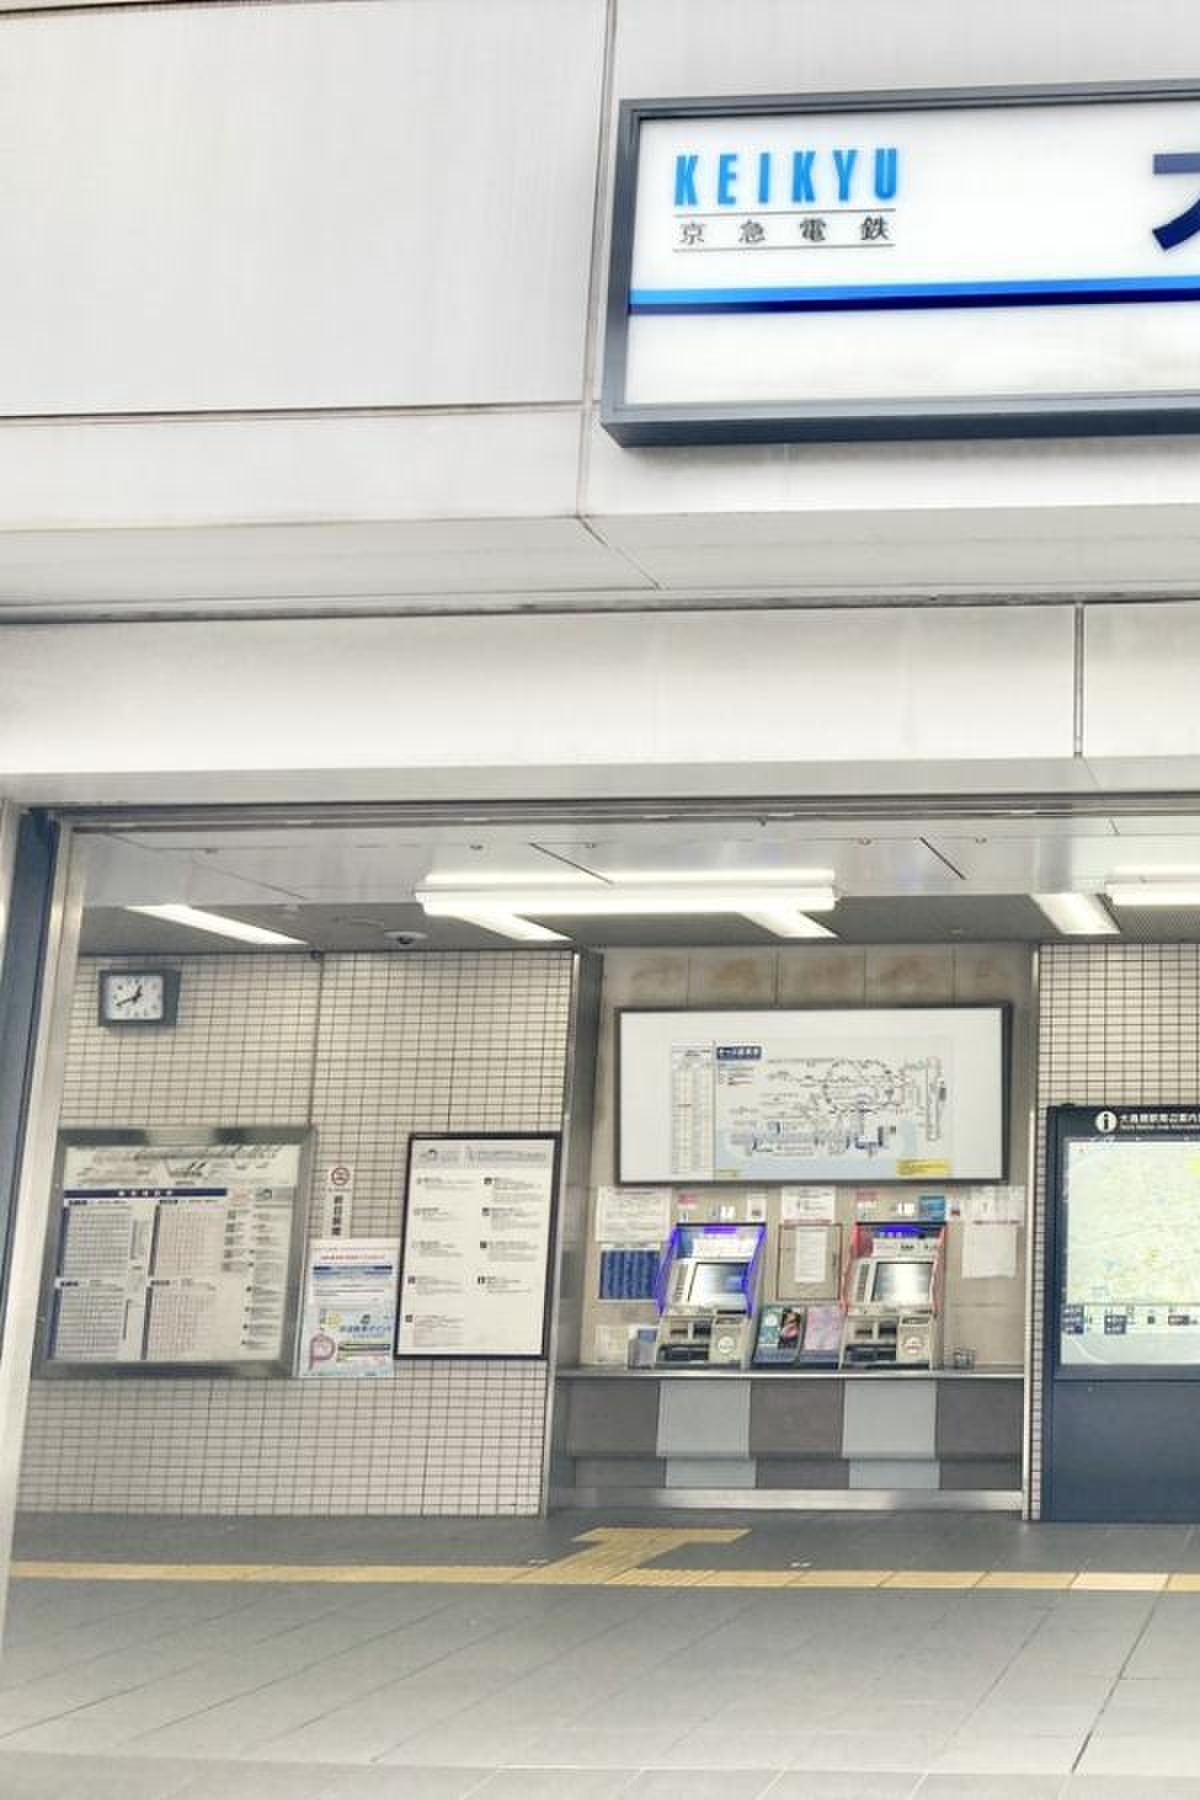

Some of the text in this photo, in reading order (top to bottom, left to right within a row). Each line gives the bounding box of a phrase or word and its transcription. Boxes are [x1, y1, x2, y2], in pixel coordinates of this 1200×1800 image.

[673, 147, 898, 207] KEIKYU
[679, 215, 890, 245] 京急電鉄
